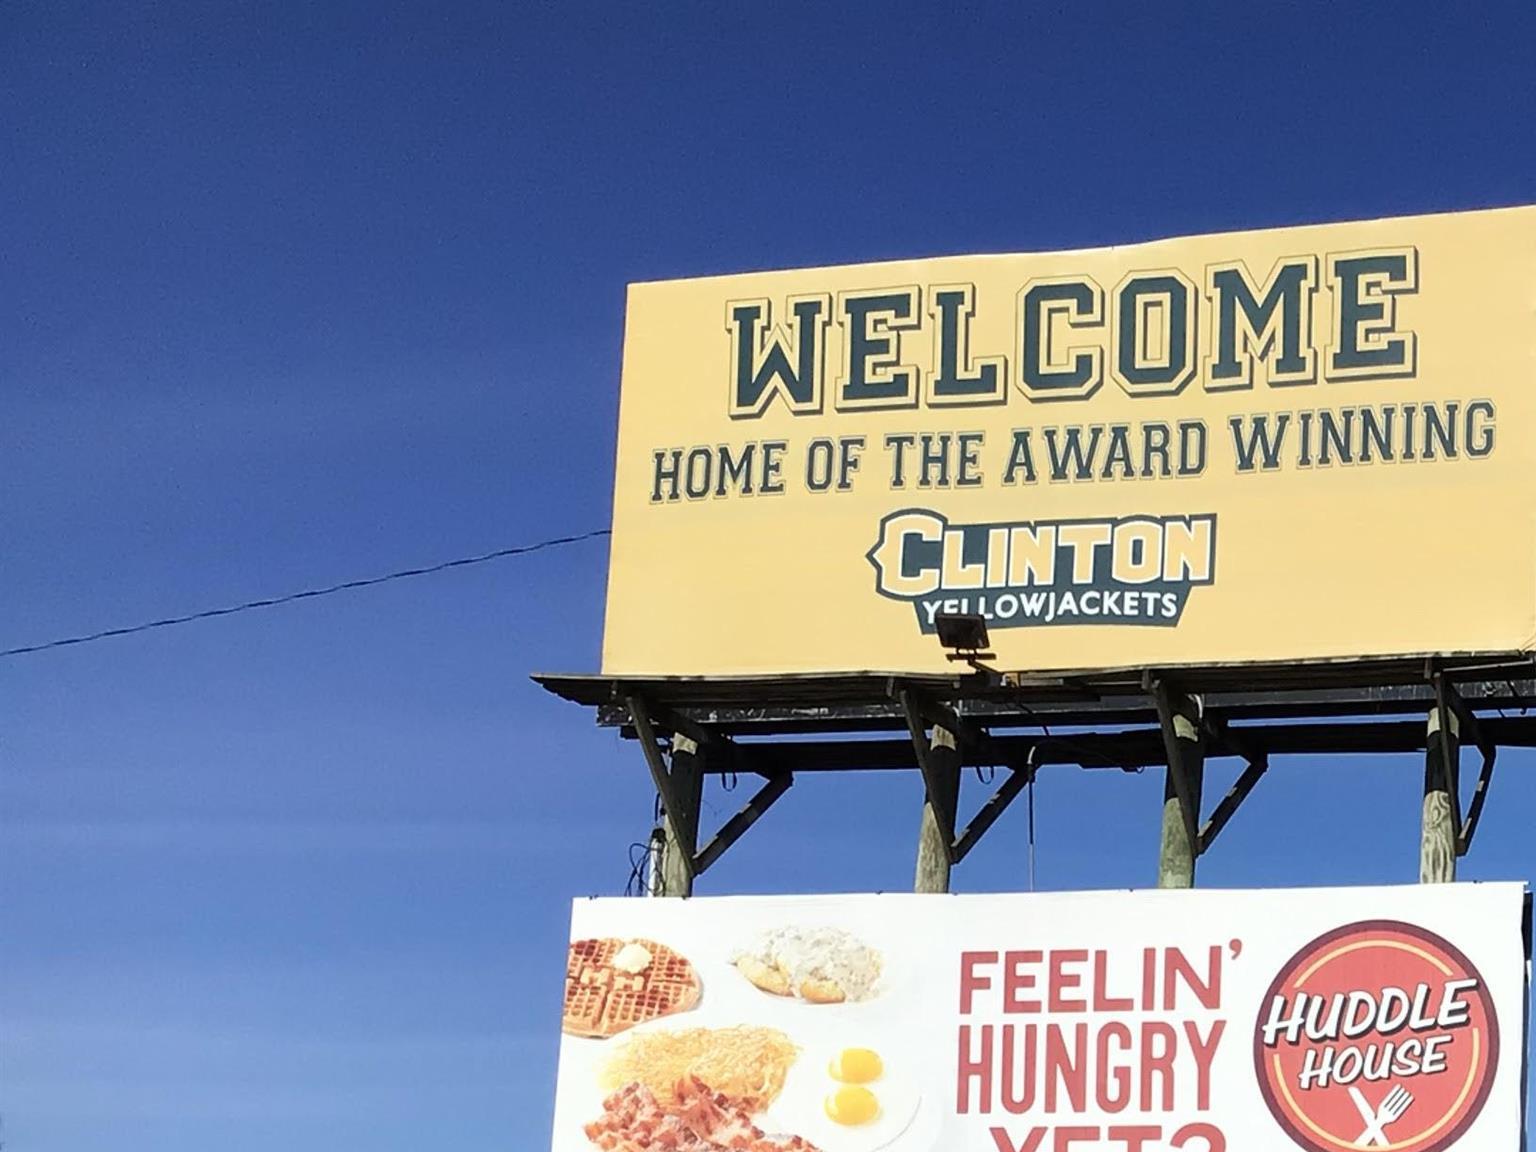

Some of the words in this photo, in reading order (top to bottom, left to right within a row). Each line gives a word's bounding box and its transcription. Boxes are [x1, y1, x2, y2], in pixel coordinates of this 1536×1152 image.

[726, 245, 1419, 419] WELCOME
[650, 439, 789, 503] HOME
[803, 434, 867, 493] OF
[883, 430, 985, 489] THE
[1001, 418, 1208, 485] AWARD
[1228, 399, 1496, 474] WINNING
[872, 513, 1213, 597] CLINTON
[1262, 979, 1478, 1047] HUDDLE
[956, 1019, 1227, 1115] HUNGRY
[1299, 1035, 1453, 1090] HOUSE
